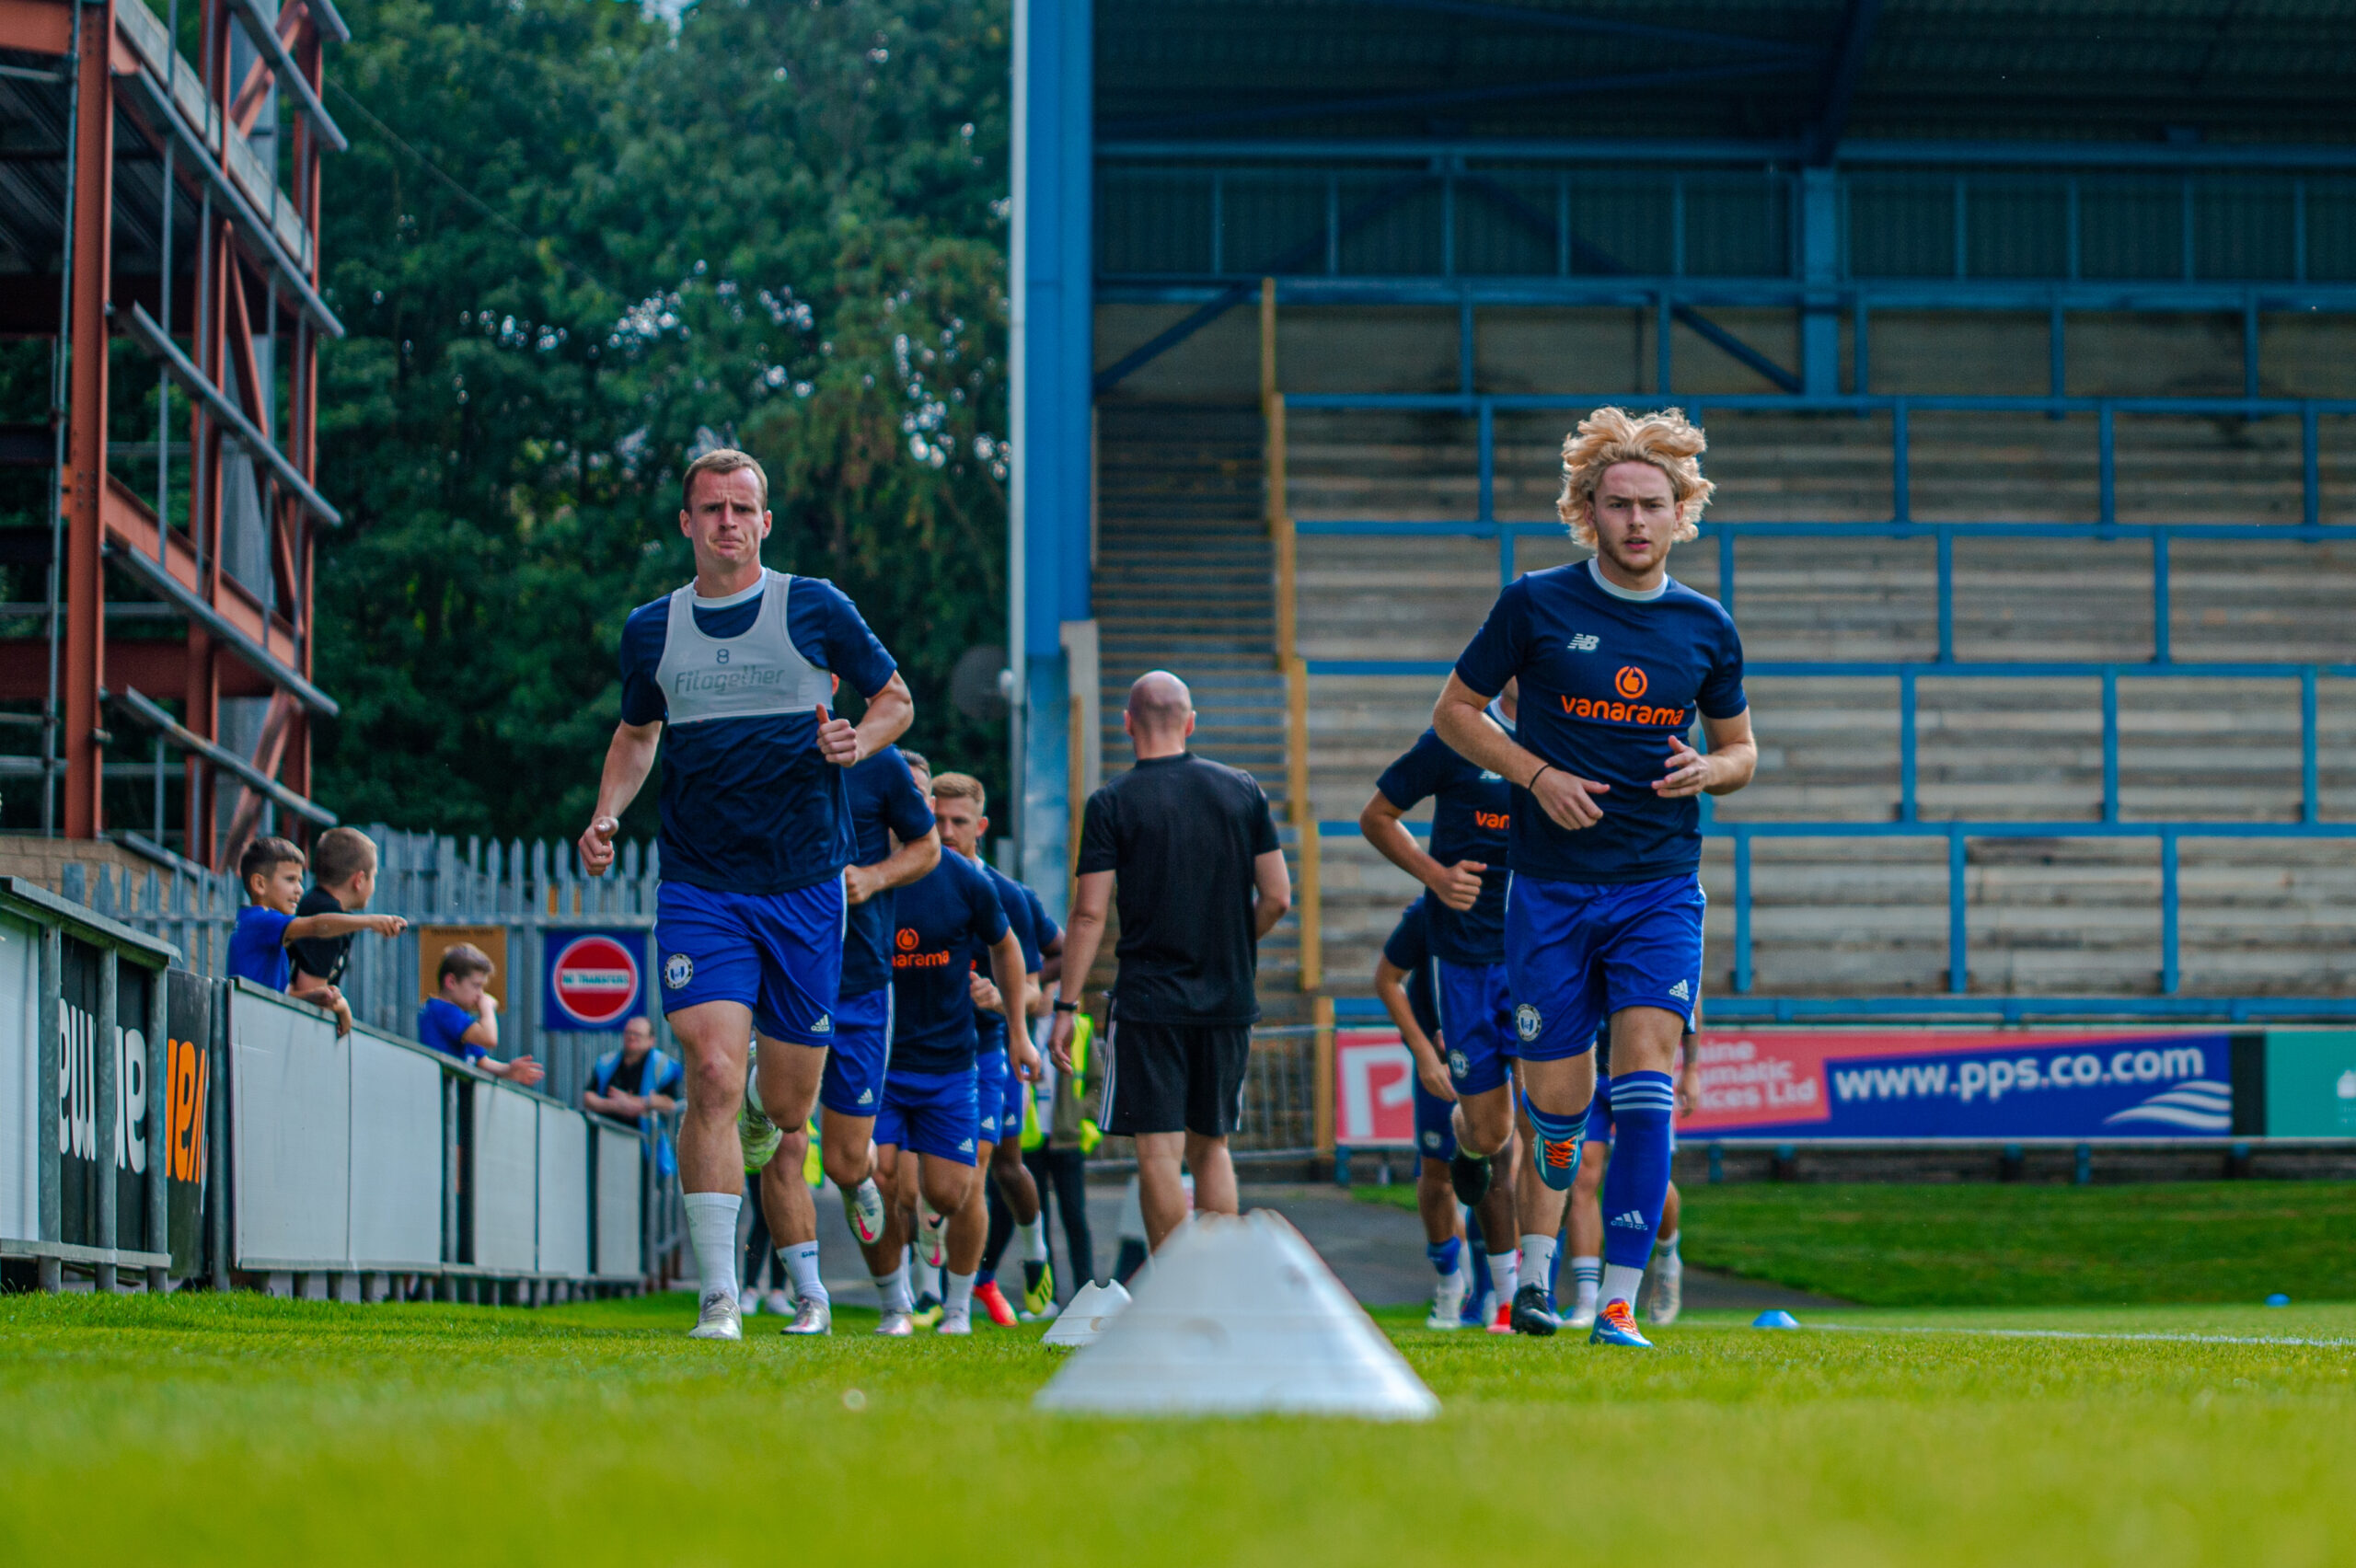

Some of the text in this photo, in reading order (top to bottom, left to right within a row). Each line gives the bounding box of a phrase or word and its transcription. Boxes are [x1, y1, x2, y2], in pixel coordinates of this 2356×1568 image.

[717, 649, 730, 663] 8
[1561, 695, 1685, 726] vanarama
[1835, 1047, 2205, 1101] www.pps.co.com
